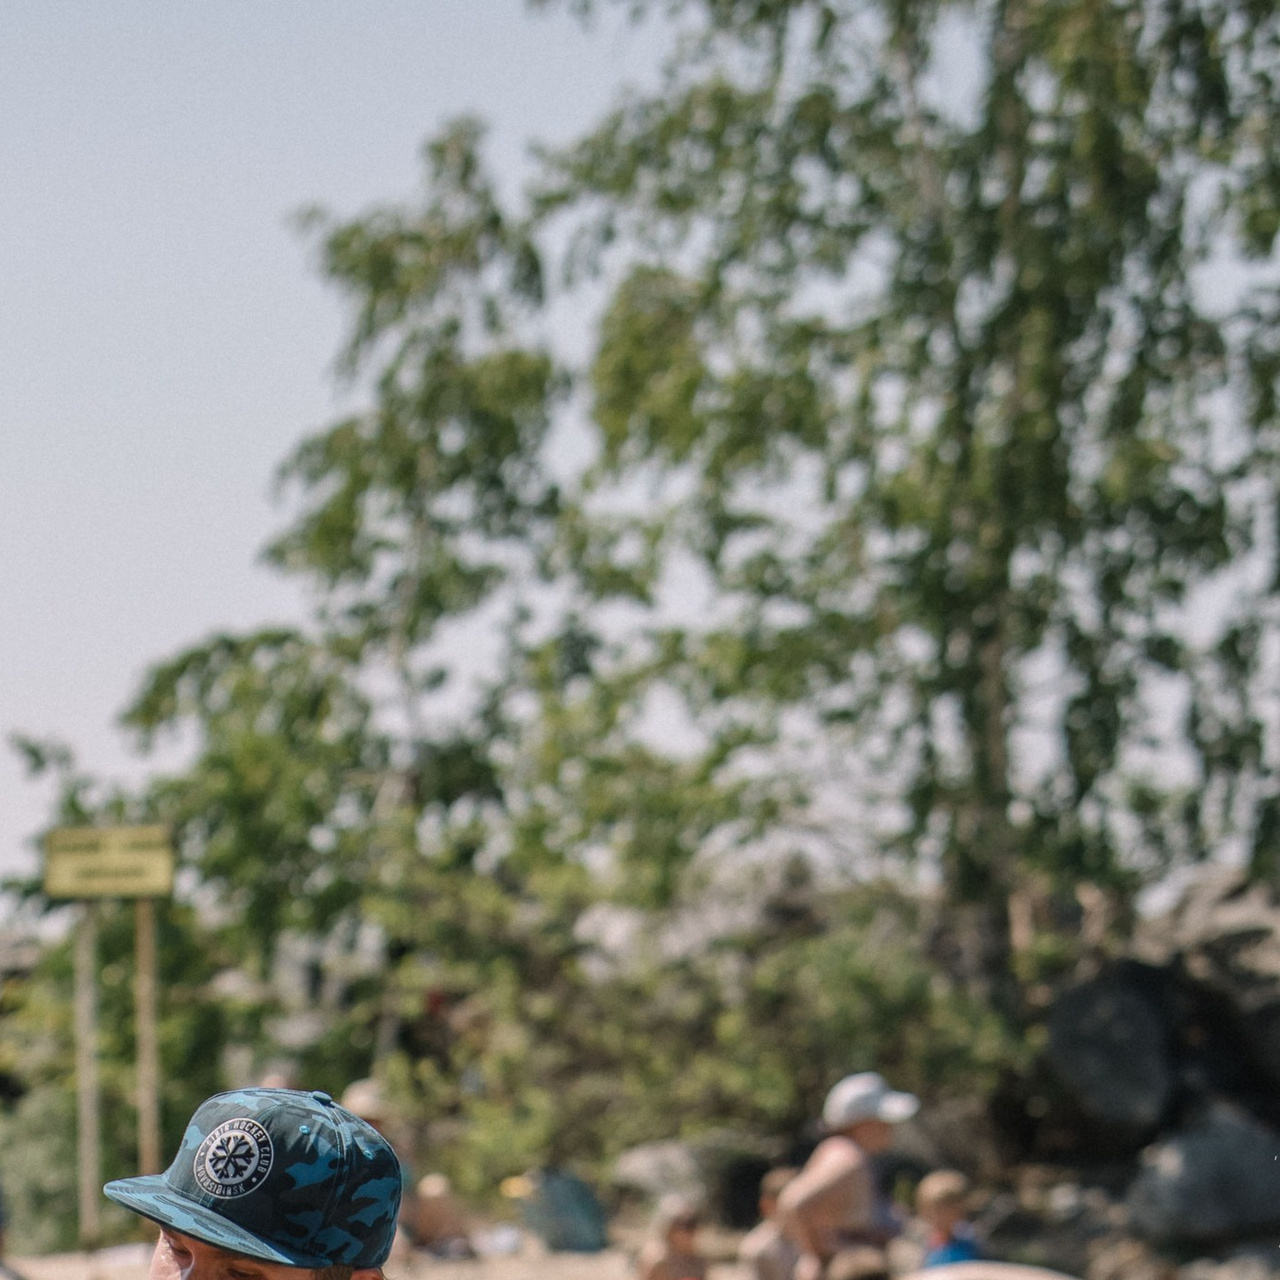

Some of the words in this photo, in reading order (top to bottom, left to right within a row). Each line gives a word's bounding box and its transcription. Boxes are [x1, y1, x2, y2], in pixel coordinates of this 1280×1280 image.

[233, 1120, 268, 1143] HOCKEY
[257, 1146, 271, 1173] CLUB
[197, 1164, 246, 1196] NOVOSIBIRSK
